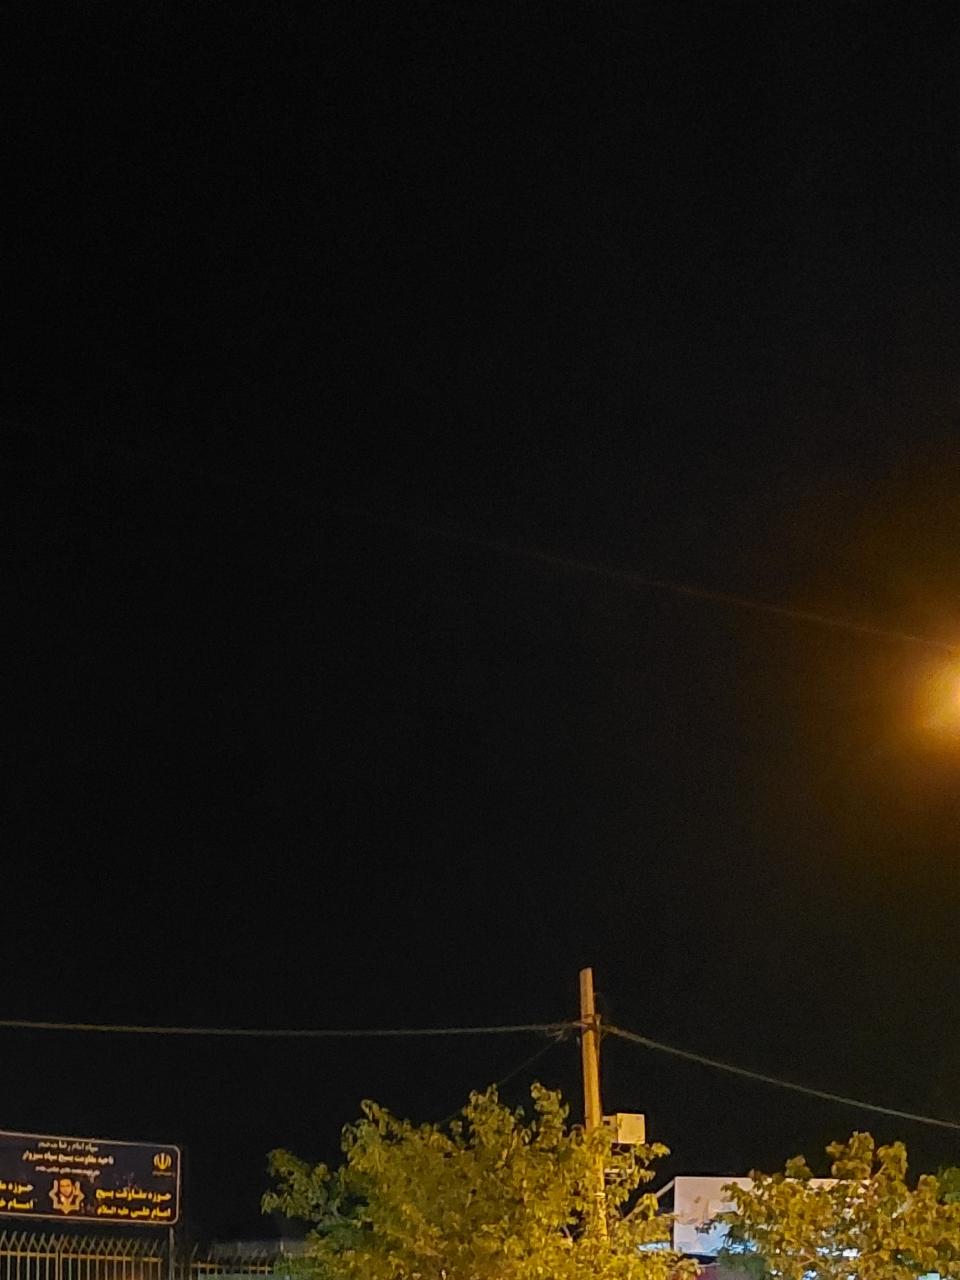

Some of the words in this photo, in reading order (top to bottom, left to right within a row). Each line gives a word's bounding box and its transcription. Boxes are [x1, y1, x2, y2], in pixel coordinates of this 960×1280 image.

[8, 1182, 34, 1193] حوزه
[96, 1189, 114, 1199] بسیج
[148, 1191, 172, 1202] حوزه
[8, 1197, 33, 1210] امام
[130, 1206, 150, 1217] علی
[151, 1206, 171, 1218] امام
